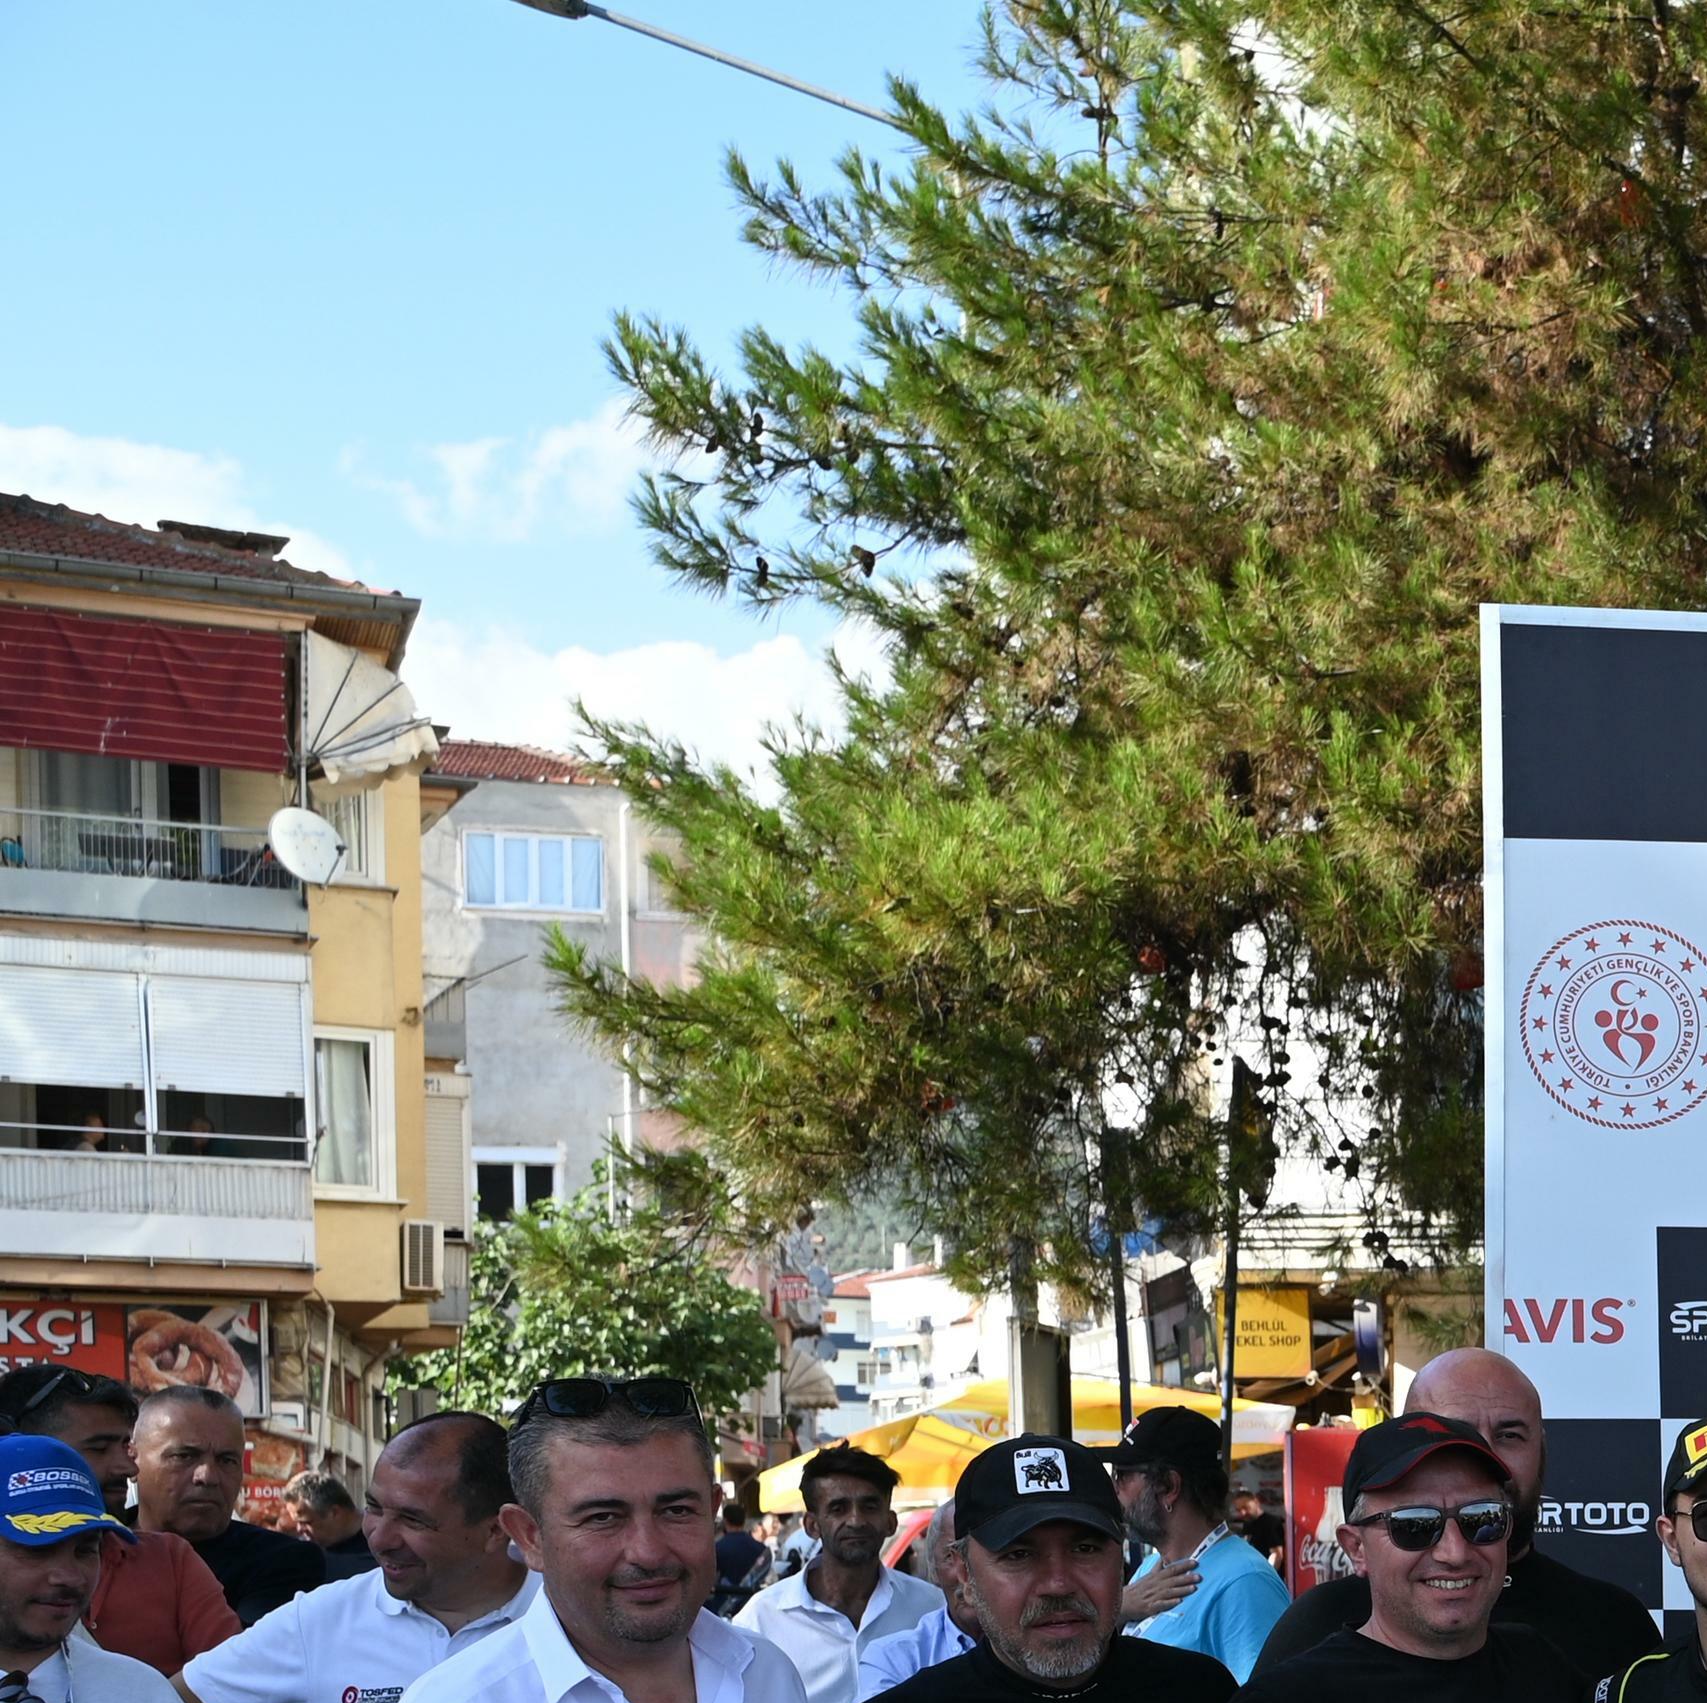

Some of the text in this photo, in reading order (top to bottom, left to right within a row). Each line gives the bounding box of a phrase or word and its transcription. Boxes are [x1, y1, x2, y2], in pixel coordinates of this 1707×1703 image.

[1559, 958, 1694, 1089] TÜRKİYE CUMHURİYETİ GENÇLİK VE SPOR BAKANLIĞI
[1241, 1318, 1287, 1332] BEHLÜL
[1504, 1299, 1624, 1344] AVIS
[1235, 1335, 1301, 1348] EKEL SHOP
[1538, 1502, 1650, 1527] RTOTO
[360, 1686, 404, 1697] TOSFED
